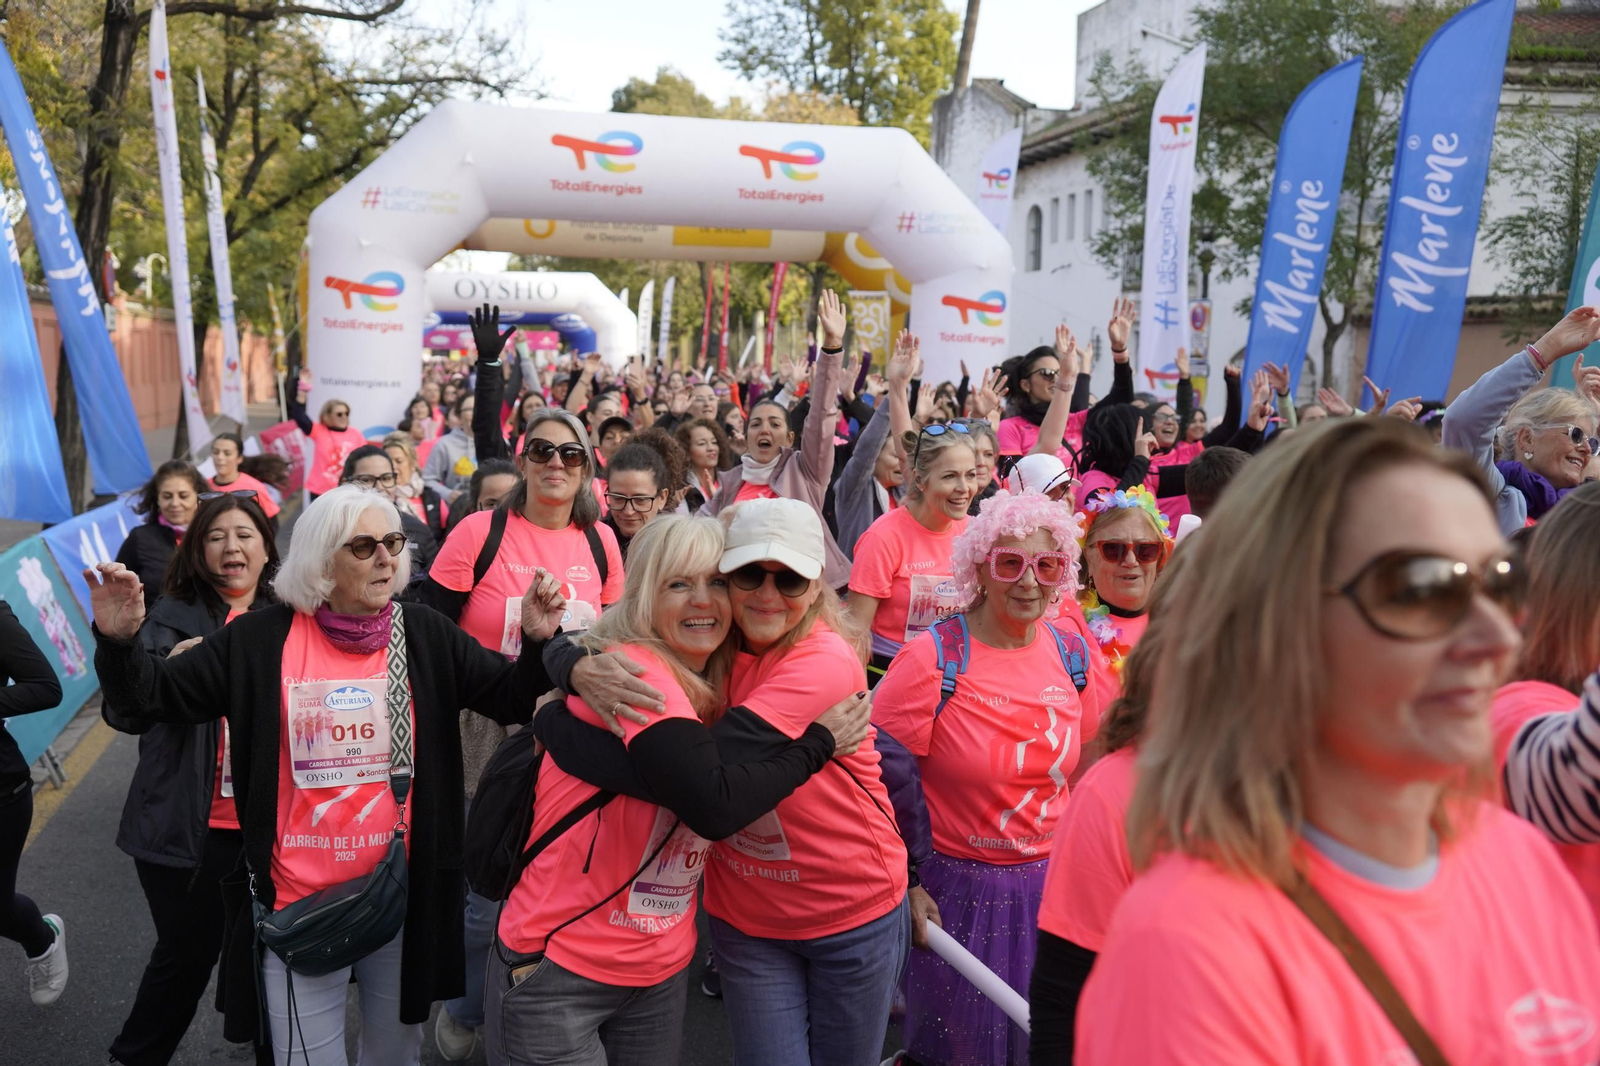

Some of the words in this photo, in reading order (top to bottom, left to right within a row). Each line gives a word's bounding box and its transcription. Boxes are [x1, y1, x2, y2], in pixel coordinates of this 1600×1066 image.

[550, 179, 644, 196] TotalEnergies
[737, 188, 825, 204] TotalEnergies
[1388, 132, 1469, 314] Marlene
[1260, 178, 1331, 334] Marlene
[454, 278, 558, 302] OYSHO
[322, 317, 404, 334] TotalEnergies
[320, 377, 402, 389] totalenergies.es
[905, 561, 936, 571] OYSHO
[298, 701, 322, 709] SUMA
[328, 696, 372, 706] ASTURIANA
[331, 722, 375, 742] 016
[345, 747, 362, 757] 990
[308, 760, 334, 768] CARRERA
[352, 757, 371, 765] MUJER
[306, 771, 343, 783] OYSHO
[366, 766, 401, 777] Santander
[283, 834, 331, 850] CARRERA
[333, 835, 349, 850] DE
[351, 834, 365, 848] LA
[368, 831, 394, 846] MUJ
[968, 835, 1018, 850] CARRERA
[334, 851, 356, 862] 2025
[742, 863, 756, 877] LA
[758, 867, 800, 882] MUJER
[650, 885, 677, 895] CARRERA
[641, 897, 679, 910] OYSHO
